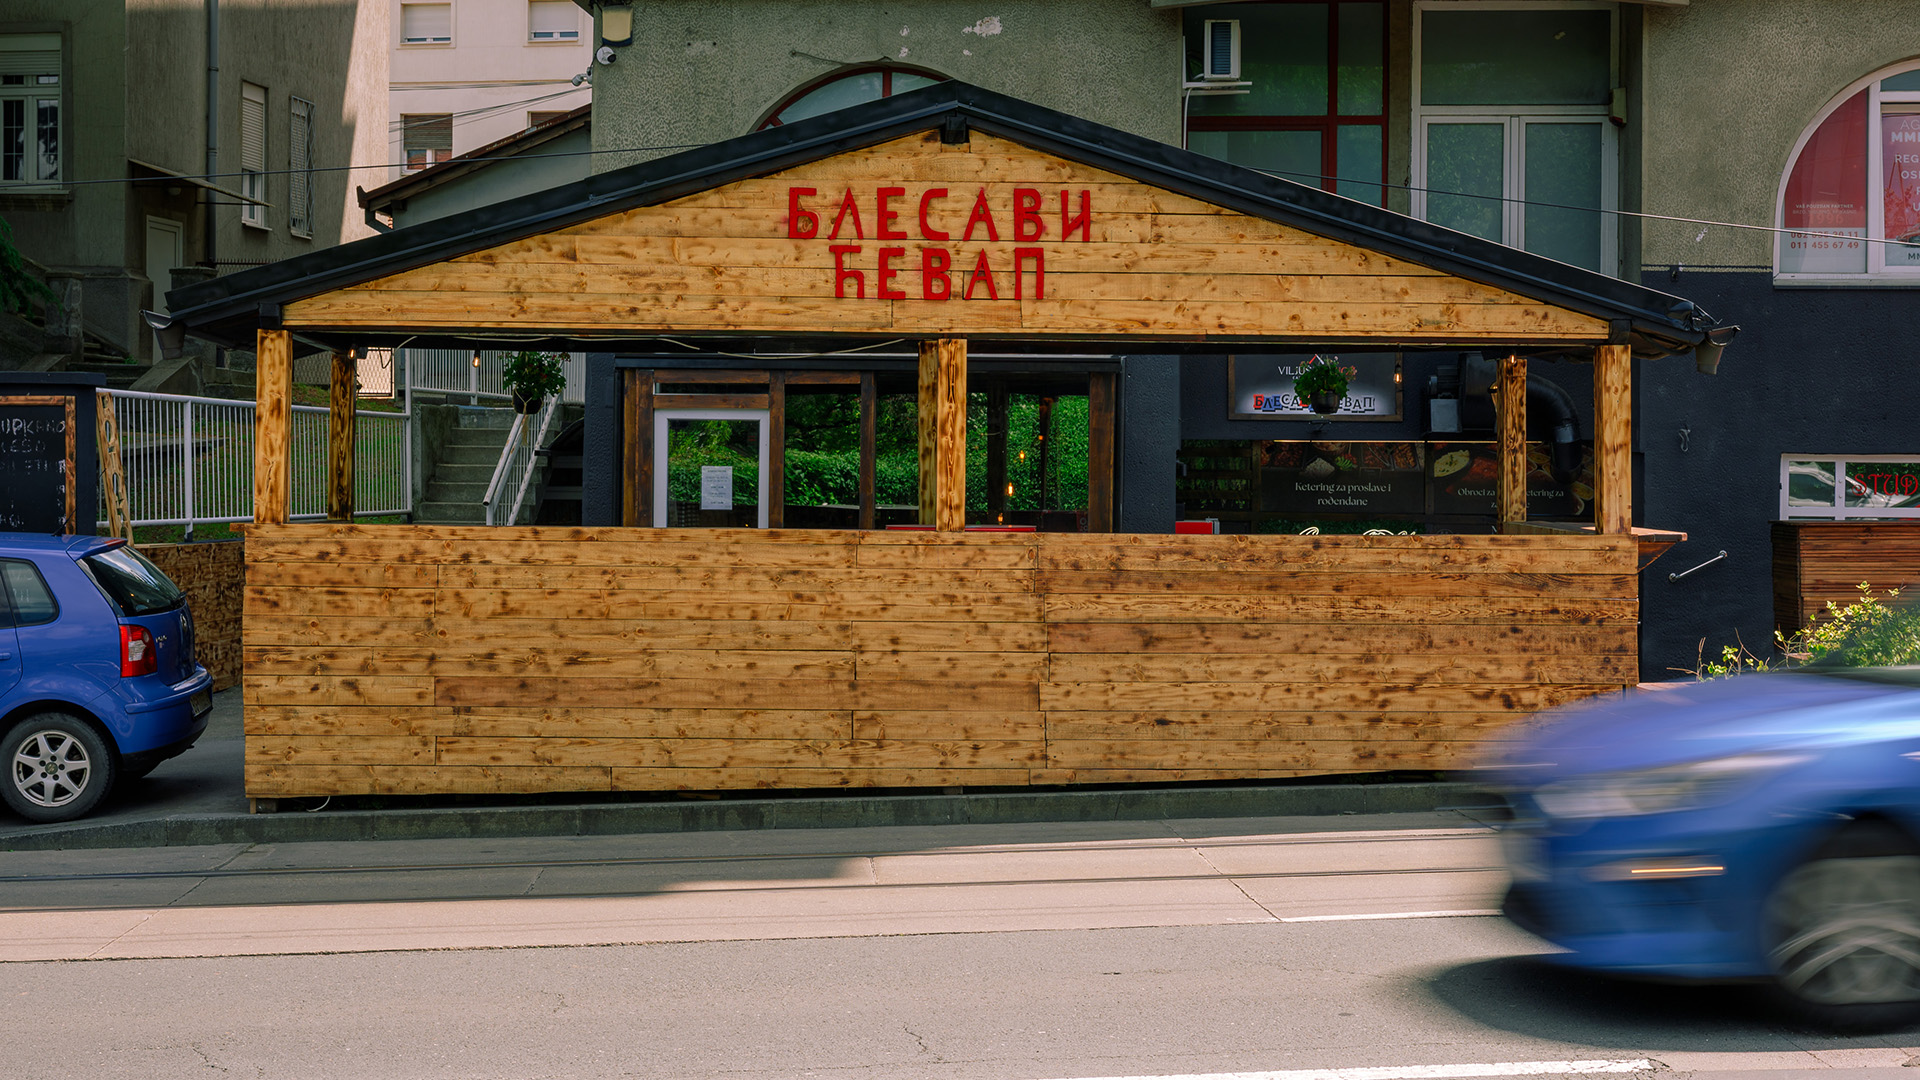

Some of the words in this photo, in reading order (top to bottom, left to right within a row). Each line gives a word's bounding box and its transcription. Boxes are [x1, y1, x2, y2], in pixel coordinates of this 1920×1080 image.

[1891, 131, 1920, 143] MM
[788, 187, 1091, 242] БЛЕСАВИ
[1790, 241, 1807, 249] 011
[1811, 241, 1829, 249] 455
[1832, 241, 1844, 249] 67
[1847, 241, 1859, 249] 49
[829, 245, 1045, 300] ЋЕВАП
[1253, 393, 1315, 411] БЛЕСА
[1295, 482, 1335, 494] Ketering
[1336, 484, 1346, 492] za
[1347, 482, 1387, 494] proslave
[1388, 483, 1392, 492] i
[1852, 473, 1918, 497] STUD
[1457, 487, 1486, 496] Obroci
[1526, 489, 1555, 499] etering
[1317, 496, 1368, 506] rođendane
